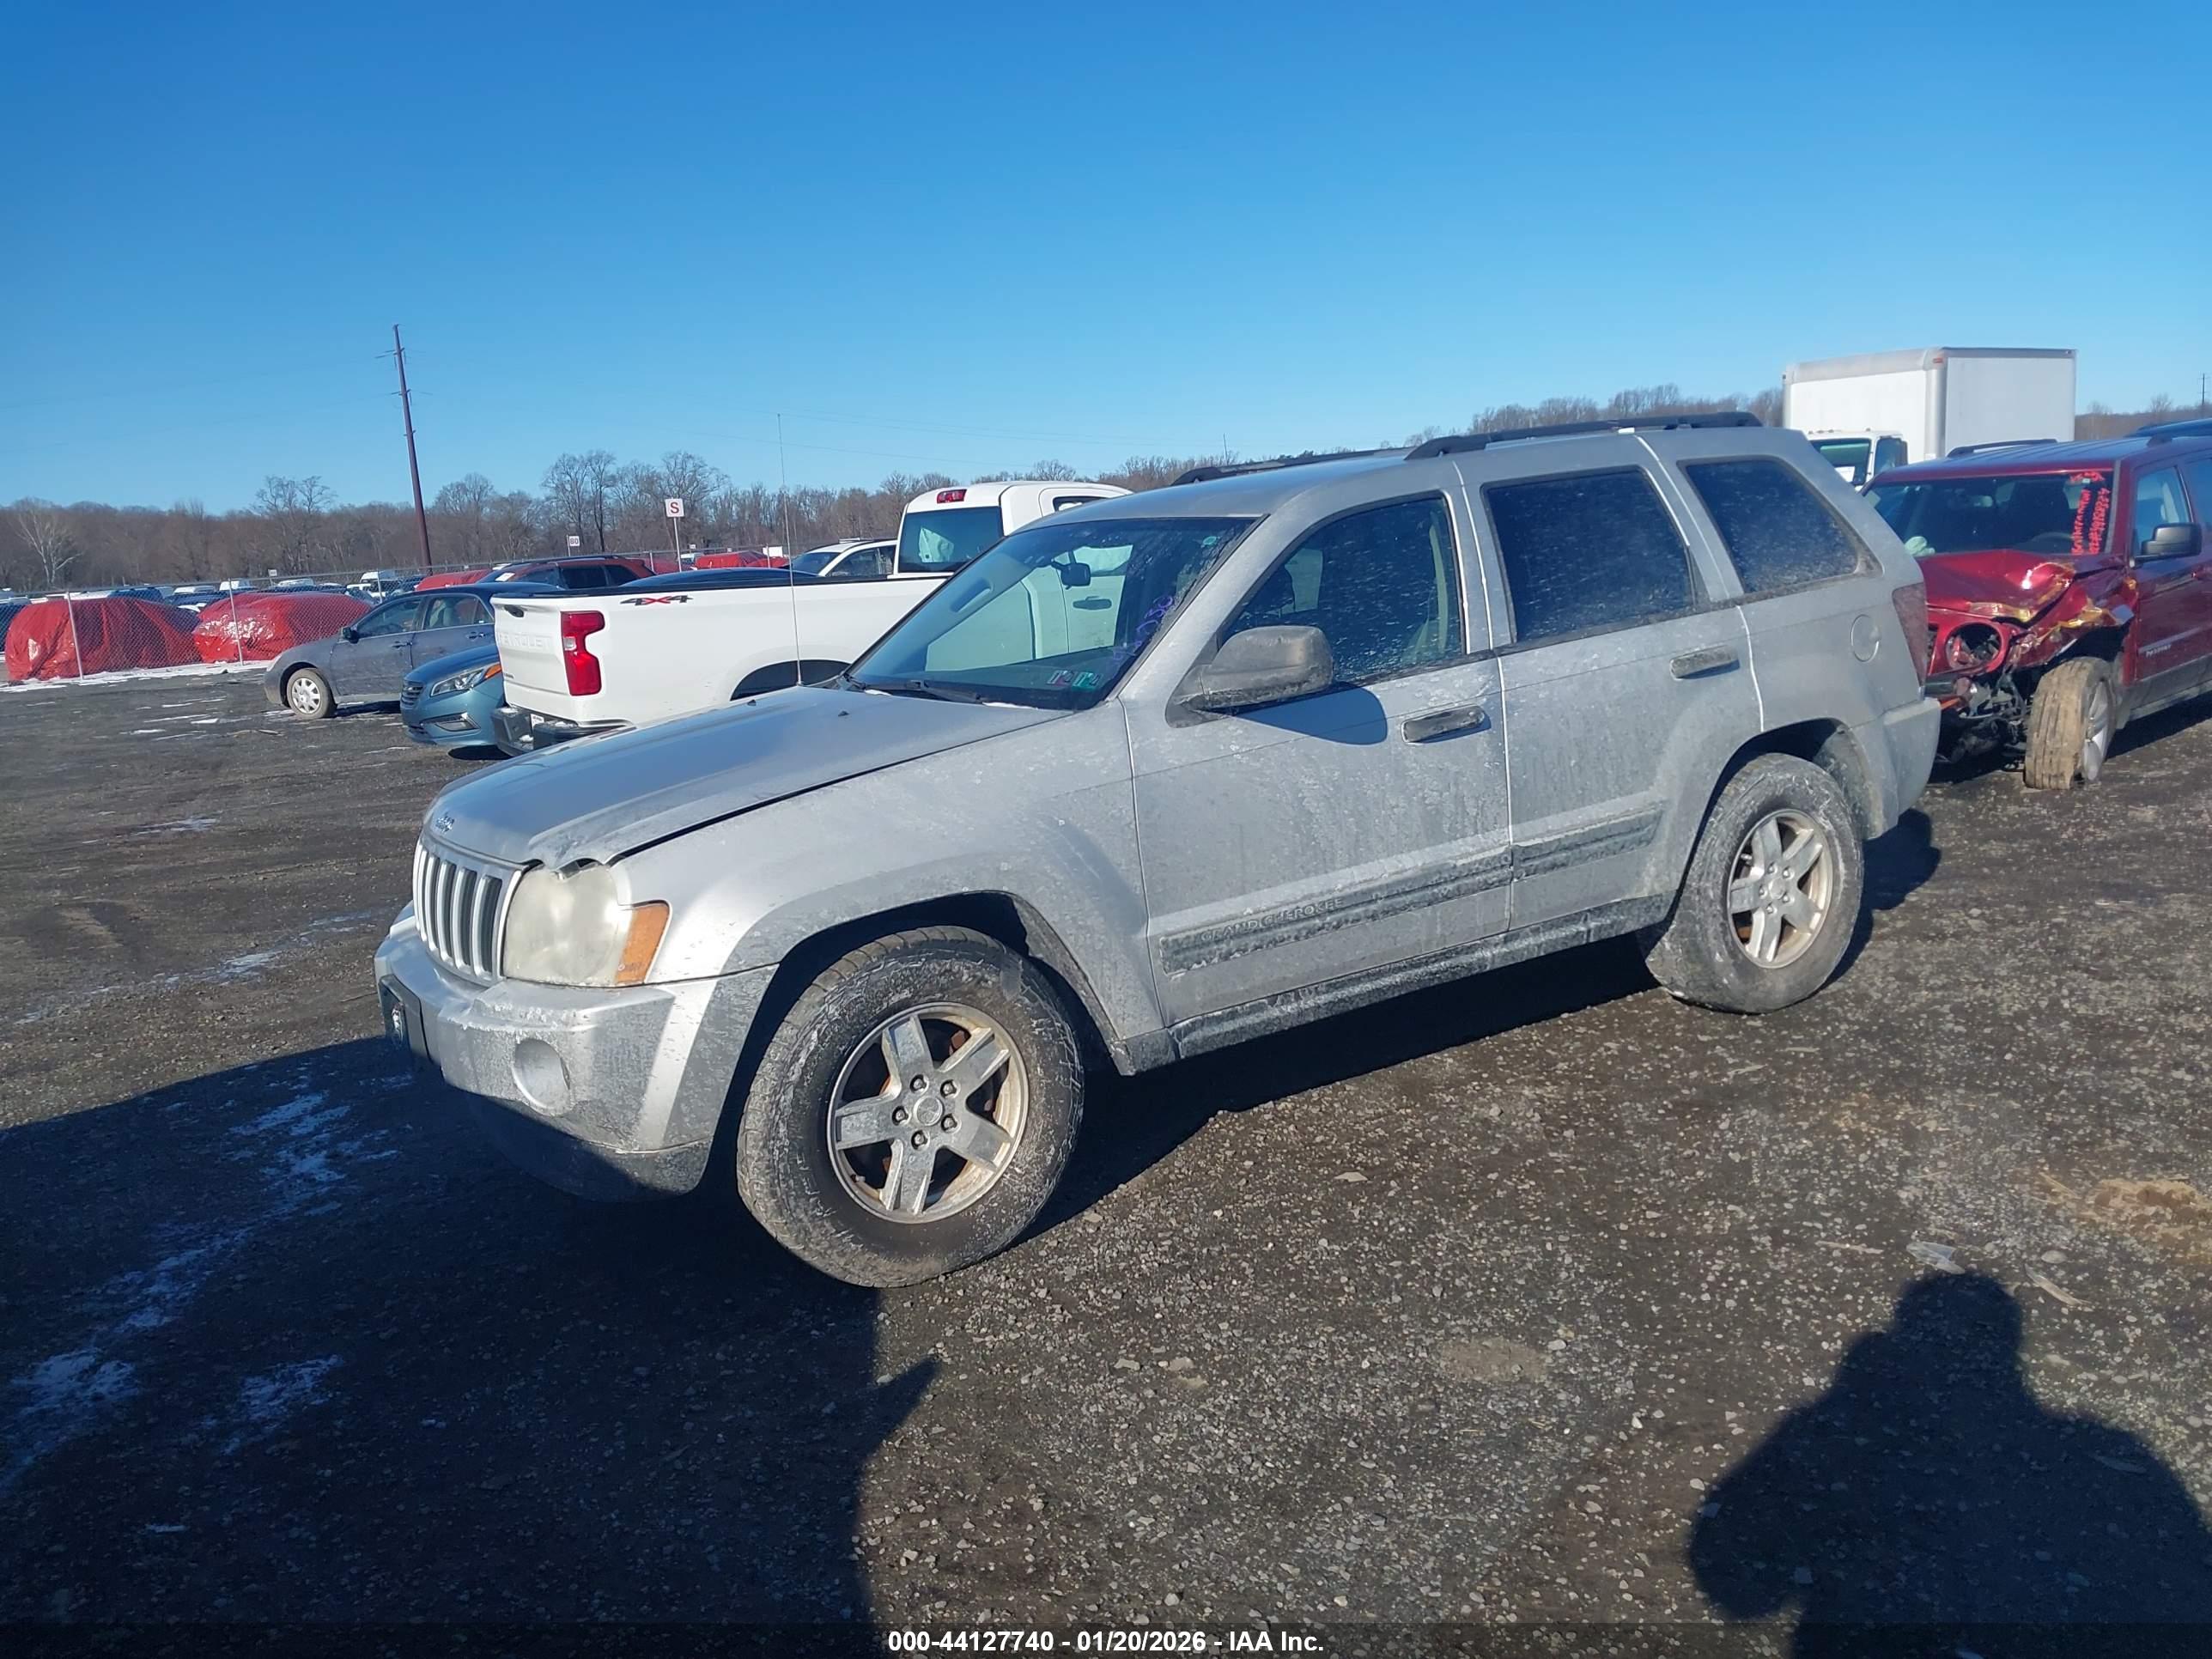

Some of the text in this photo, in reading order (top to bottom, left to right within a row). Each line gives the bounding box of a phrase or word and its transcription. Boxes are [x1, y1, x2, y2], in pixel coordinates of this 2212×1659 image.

[670, 501, 680, 514] S
[1200, 898, 1344, 942] GRAND CHEROKEE
